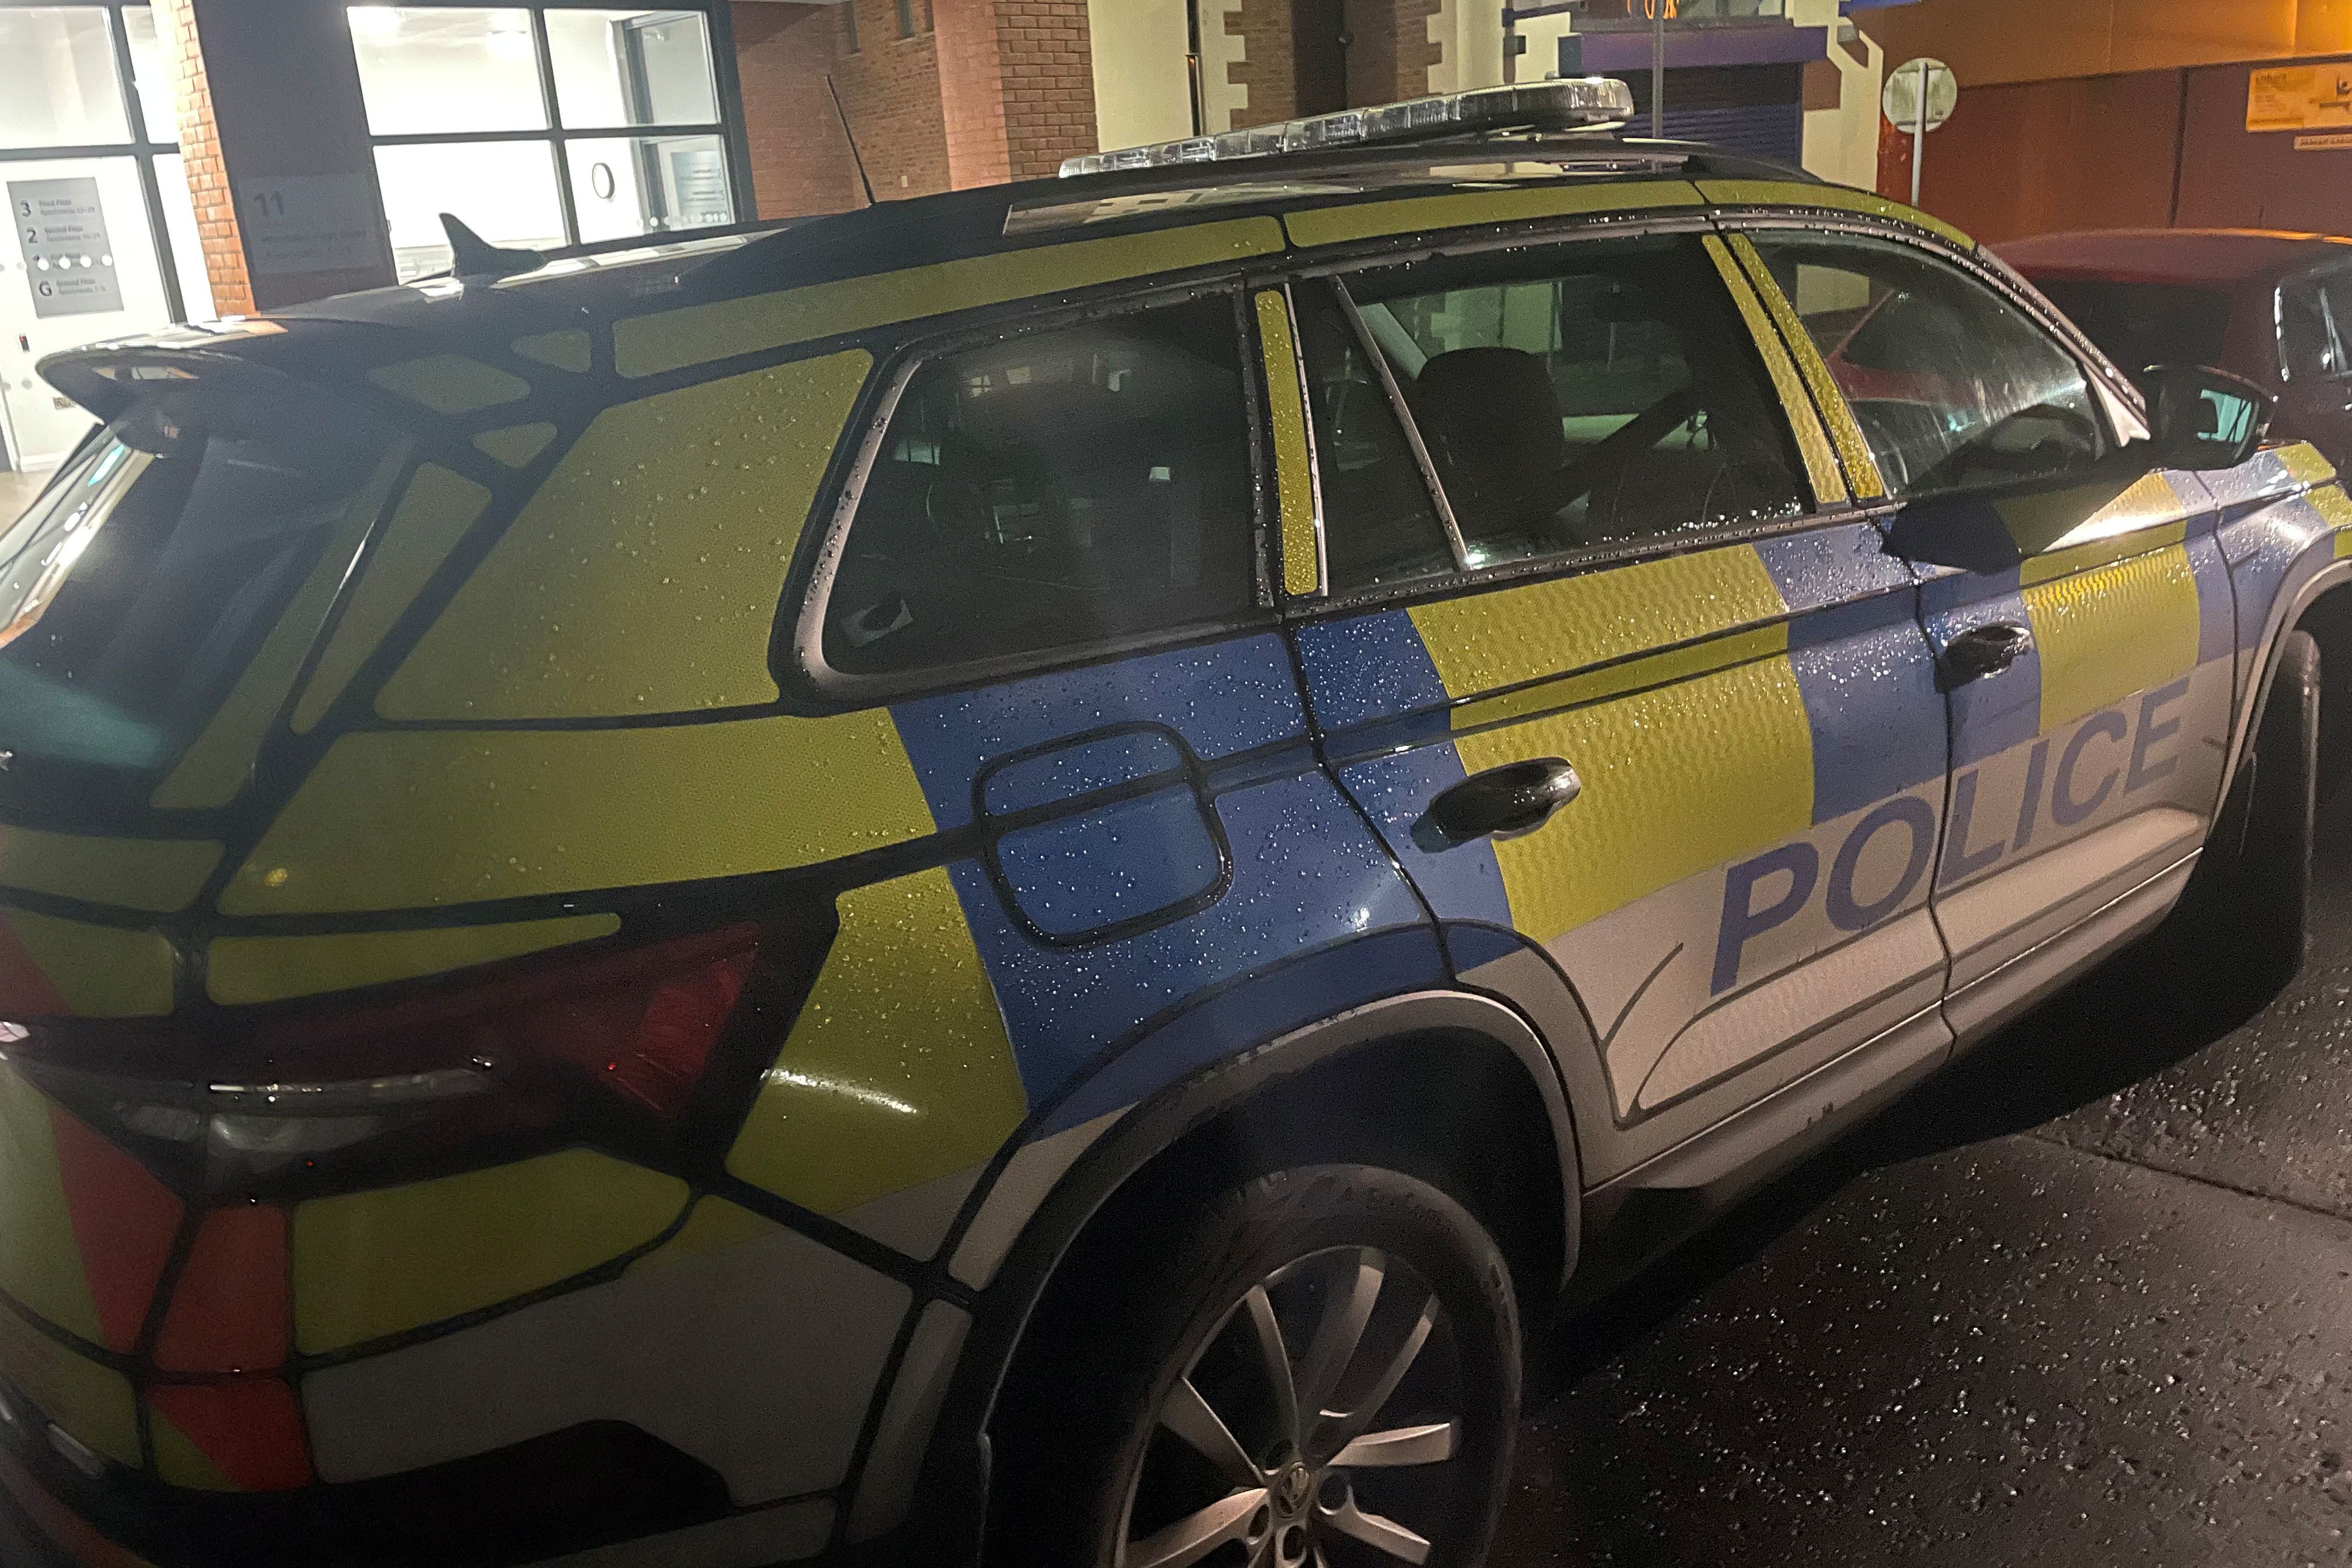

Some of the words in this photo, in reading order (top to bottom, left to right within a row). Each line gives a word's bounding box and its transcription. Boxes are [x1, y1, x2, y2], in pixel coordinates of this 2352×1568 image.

[20, 200, 32, 217] 3
[253, 190, 285, 216] 11
[27, 226, 38, 243] 2
[38, 280, 52, 297] G
[1710, 677, 2190, 996] POLICE
